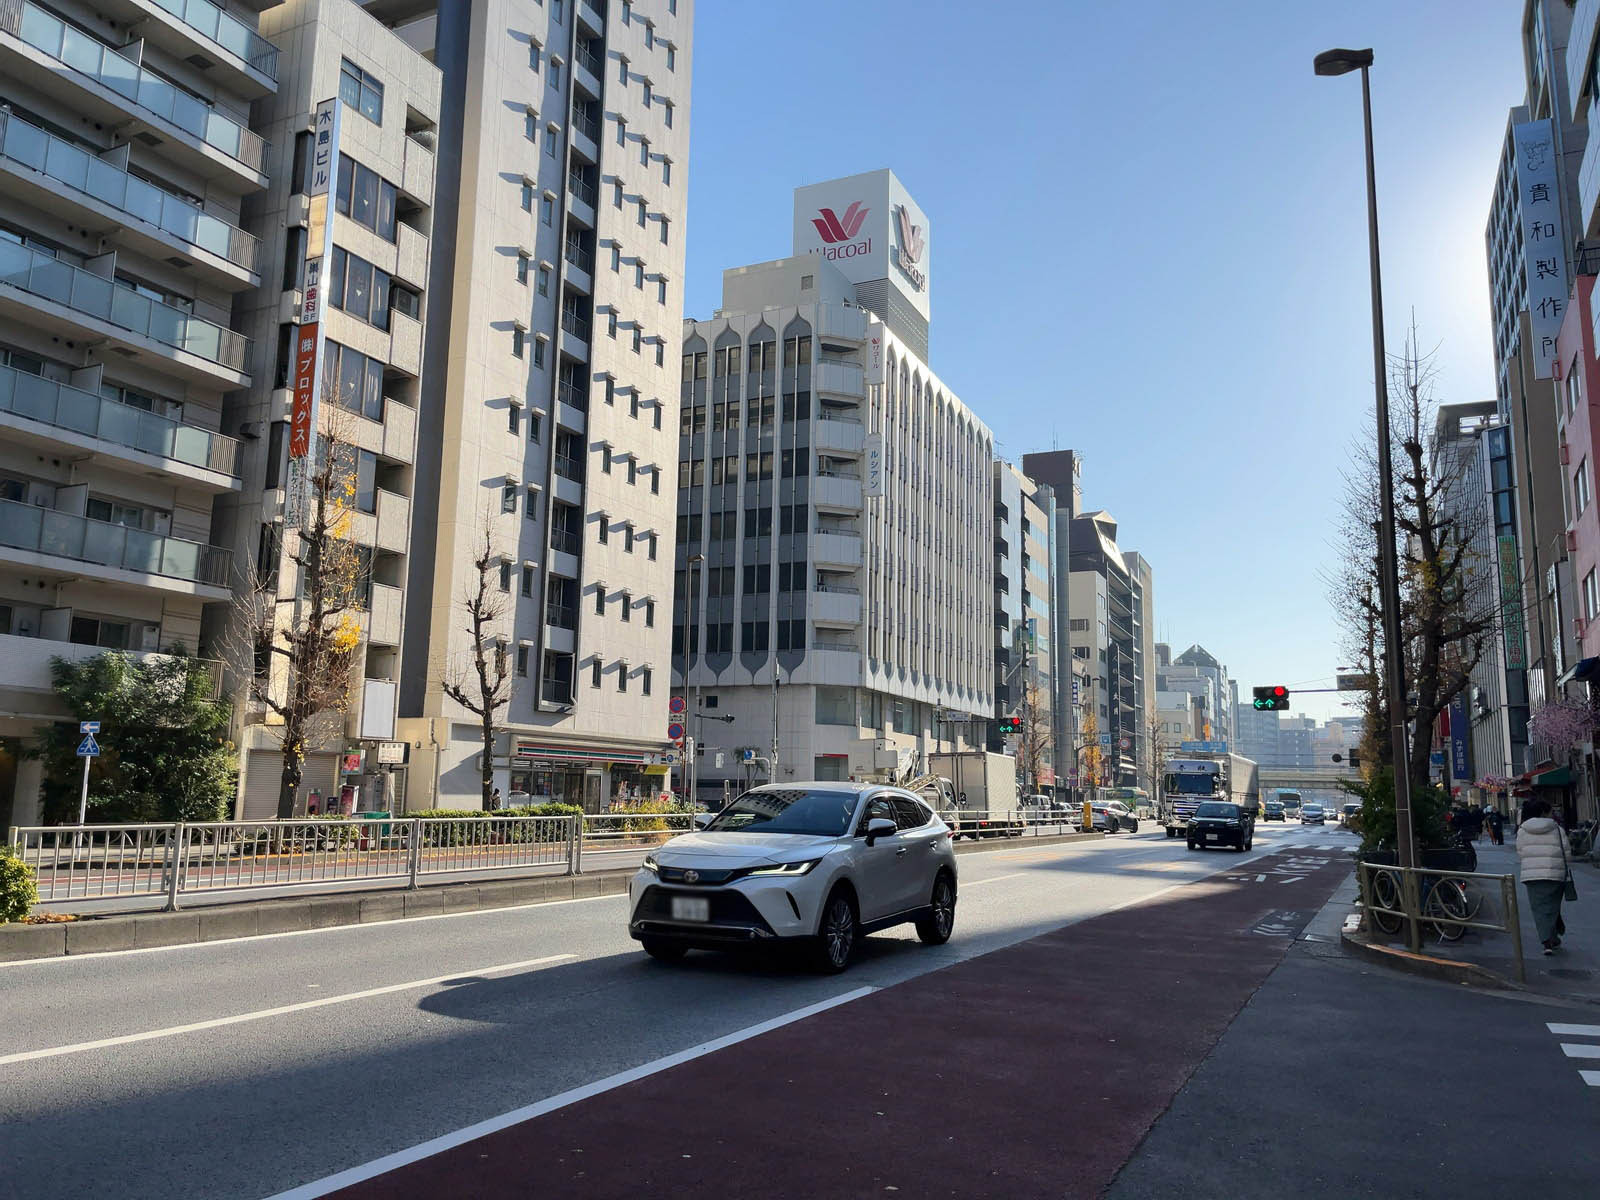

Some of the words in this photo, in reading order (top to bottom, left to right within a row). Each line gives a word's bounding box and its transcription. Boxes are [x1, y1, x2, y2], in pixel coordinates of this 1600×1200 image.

[314, 109, 332, 188] 木島ビル
[870, 449, 879, 489] ルシアン
